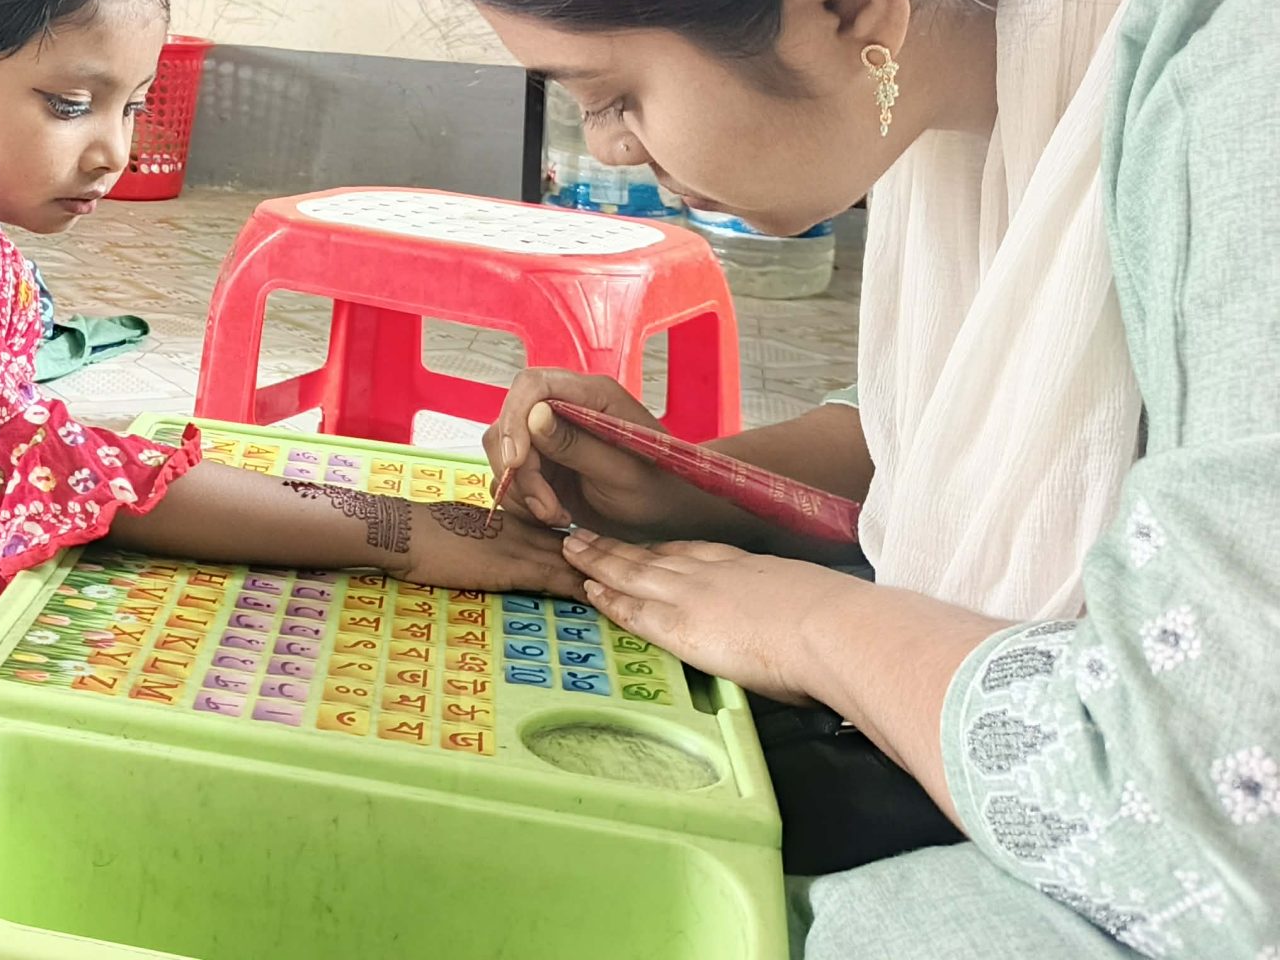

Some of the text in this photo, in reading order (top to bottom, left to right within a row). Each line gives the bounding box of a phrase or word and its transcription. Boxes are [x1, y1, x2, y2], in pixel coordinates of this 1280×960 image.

[193, 570, 227, 587] H
[135, 587, 168, 600] V
[453, 608, 486, 627] জ
[111, 625, 145, 642] X
[162, 633, 199, 650] K
[506, 599, 547, 684] 7 8 9 10
[95, 651, 132, 666] Y
[150, 656, 189, 670] L
[78, 673, 118, 690] Z
[397, 669, 428, 687] ভ
[135, 678, 179, 702] M
[449, 731, 483, 752] ড
